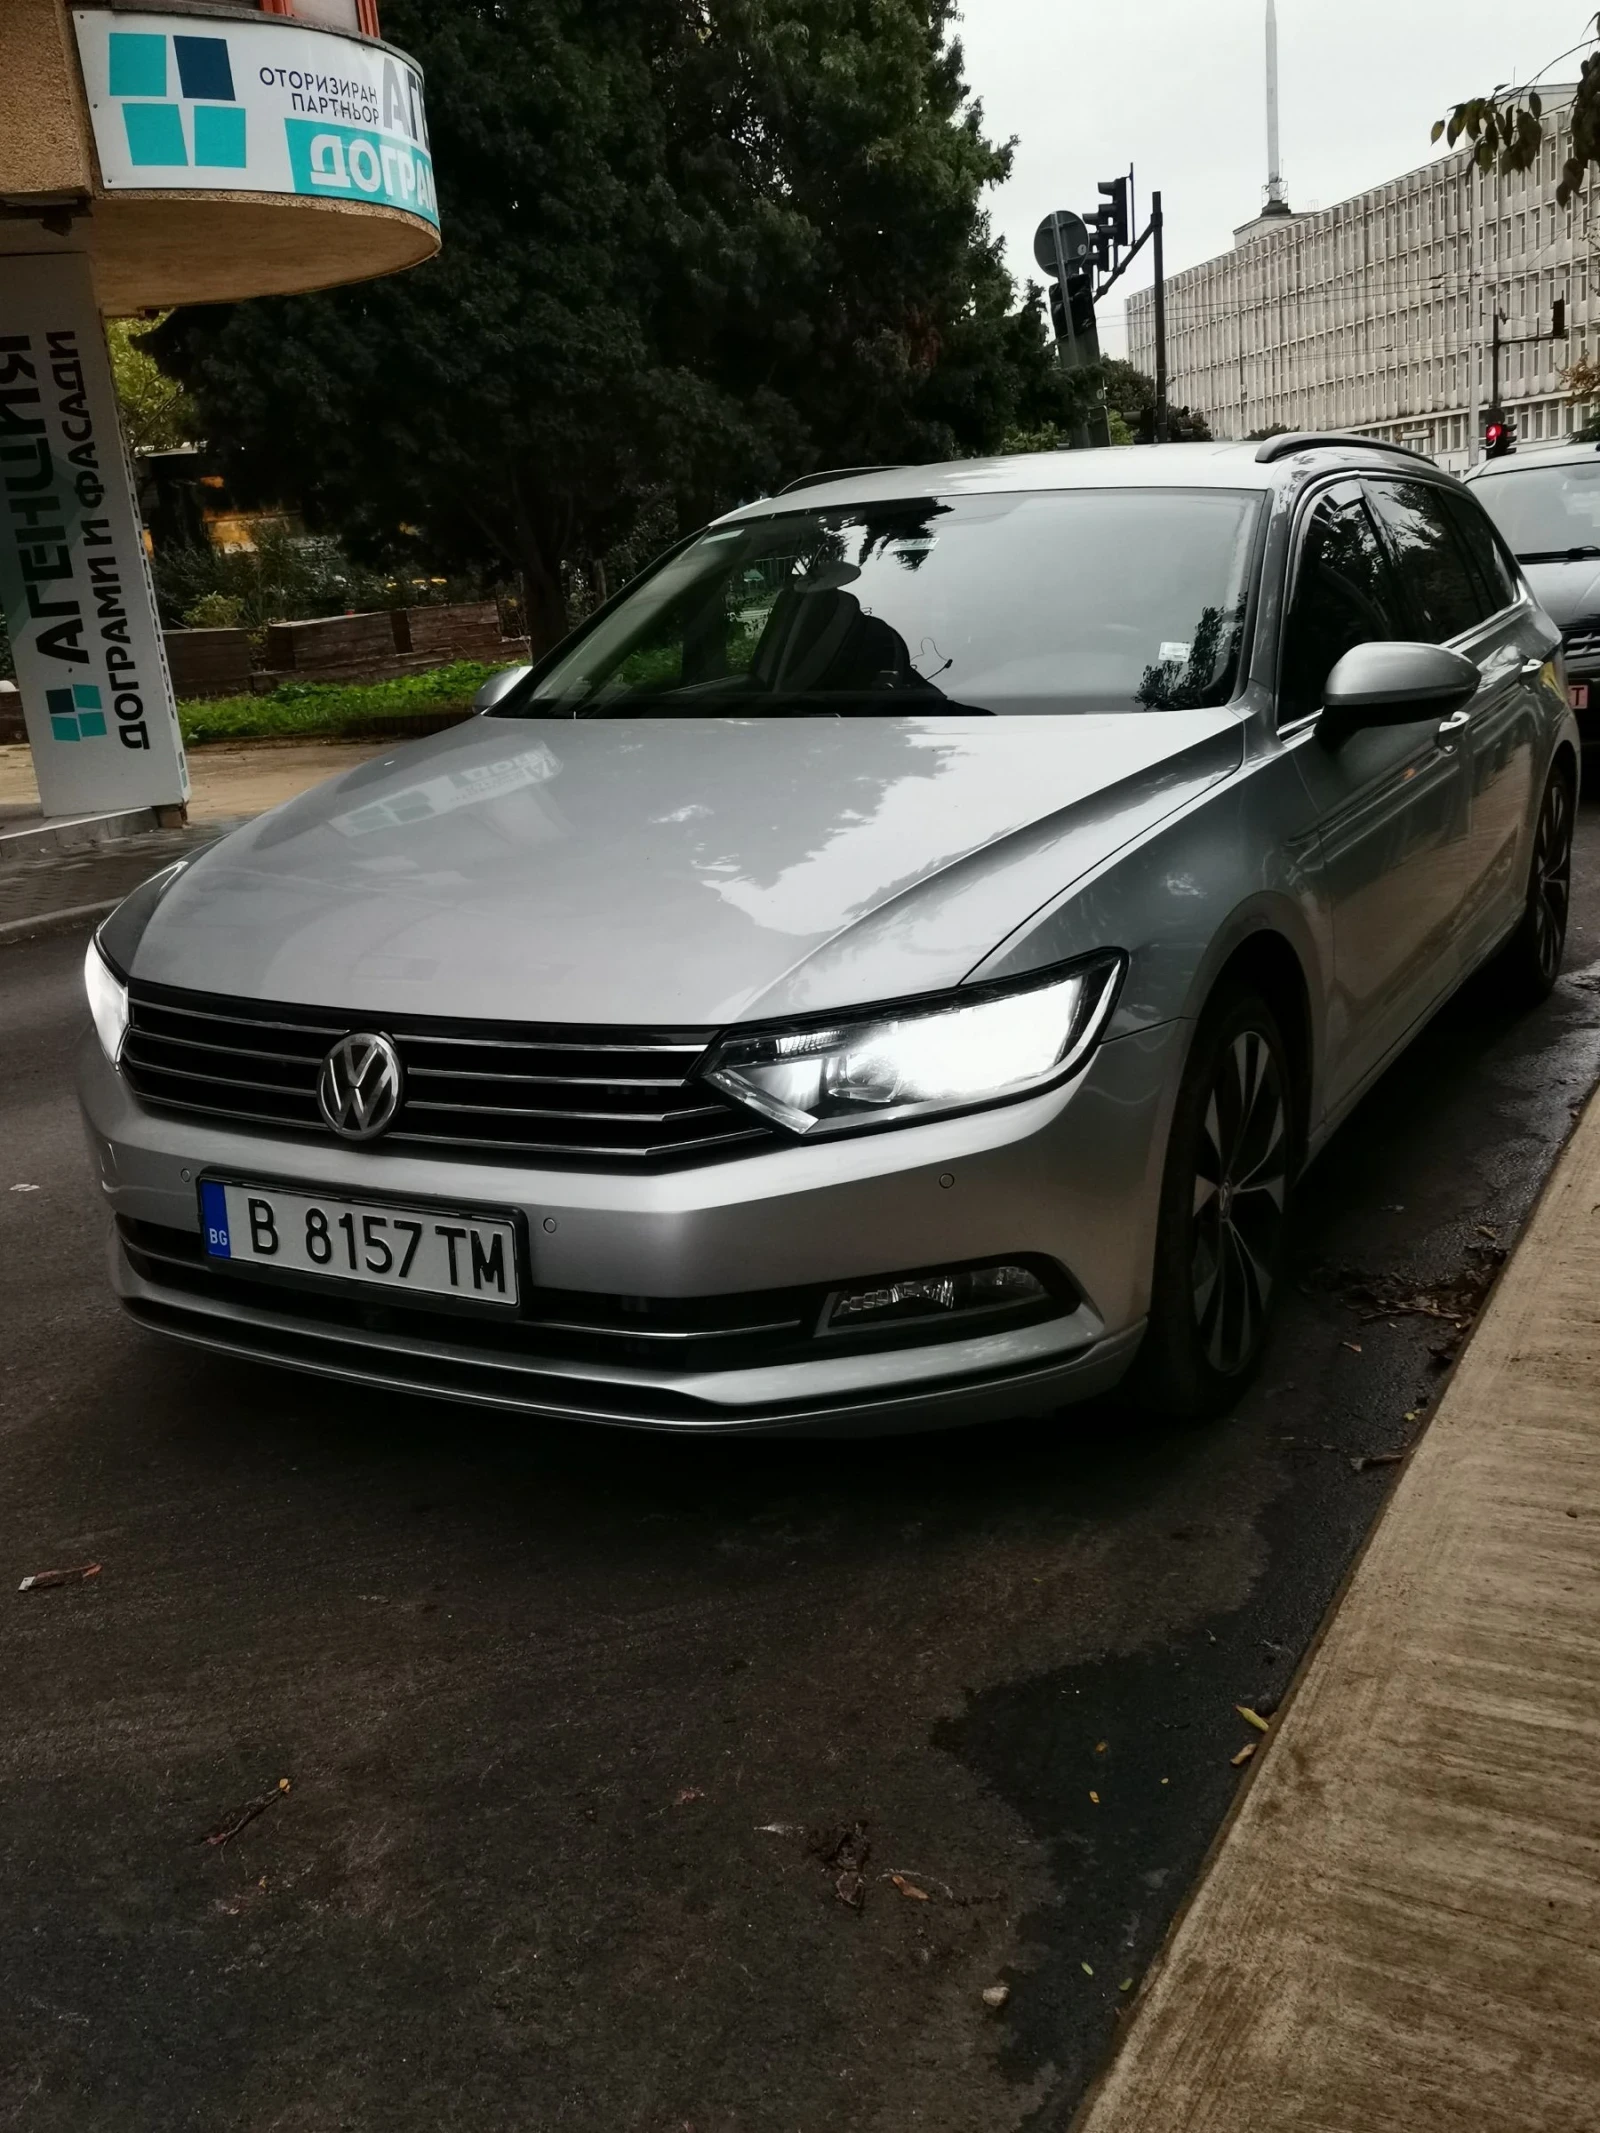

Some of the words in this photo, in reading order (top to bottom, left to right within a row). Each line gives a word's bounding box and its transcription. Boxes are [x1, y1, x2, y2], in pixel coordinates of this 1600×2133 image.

[260, 67, 378, 105] ОТОРИЗИРАН
[291, 92, 380, 125] ПАРТНЬОР
[46, 331, 105, 509] ФАСАДИ
[0, 335, 90, 664] АГЕНЦИЯ
[80, 518, 113, 546] И
[87, 556, 150, 750] ДОГРАМИ
[208, 1227, 229, 1247] BG
[248, 1197, 279, 1256] B
[305, 1207, 423, 1278] 8157
[435, 1224, 507, 1293] TM
